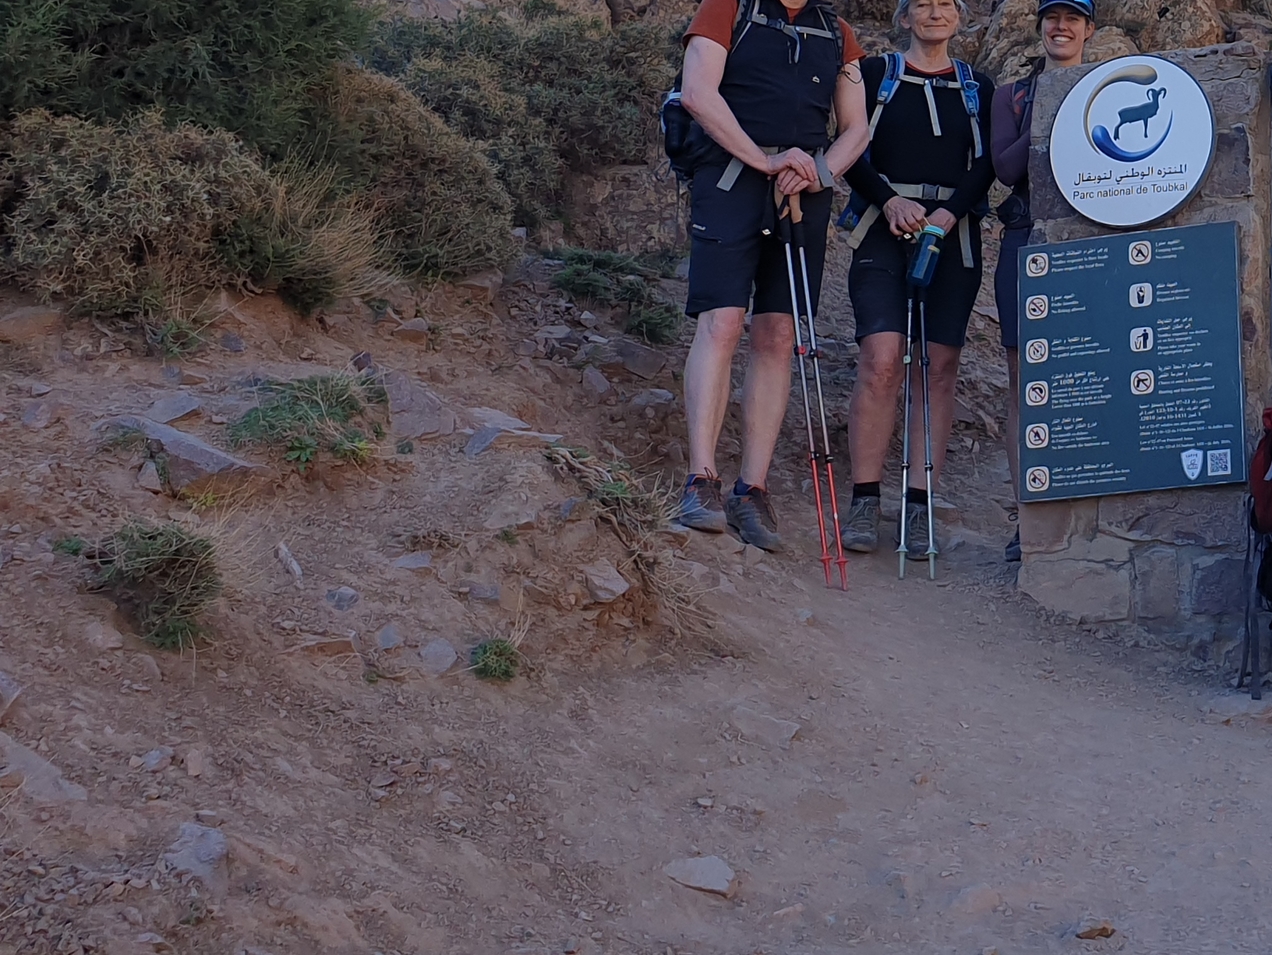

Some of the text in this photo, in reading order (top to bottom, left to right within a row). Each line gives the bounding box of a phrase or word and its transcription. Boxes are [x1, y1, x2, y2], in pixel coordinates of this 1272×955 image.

[1115, 166, 1154, 185] الوطني
[1073, 181, 1188, 201] Parc national de Toubkal
